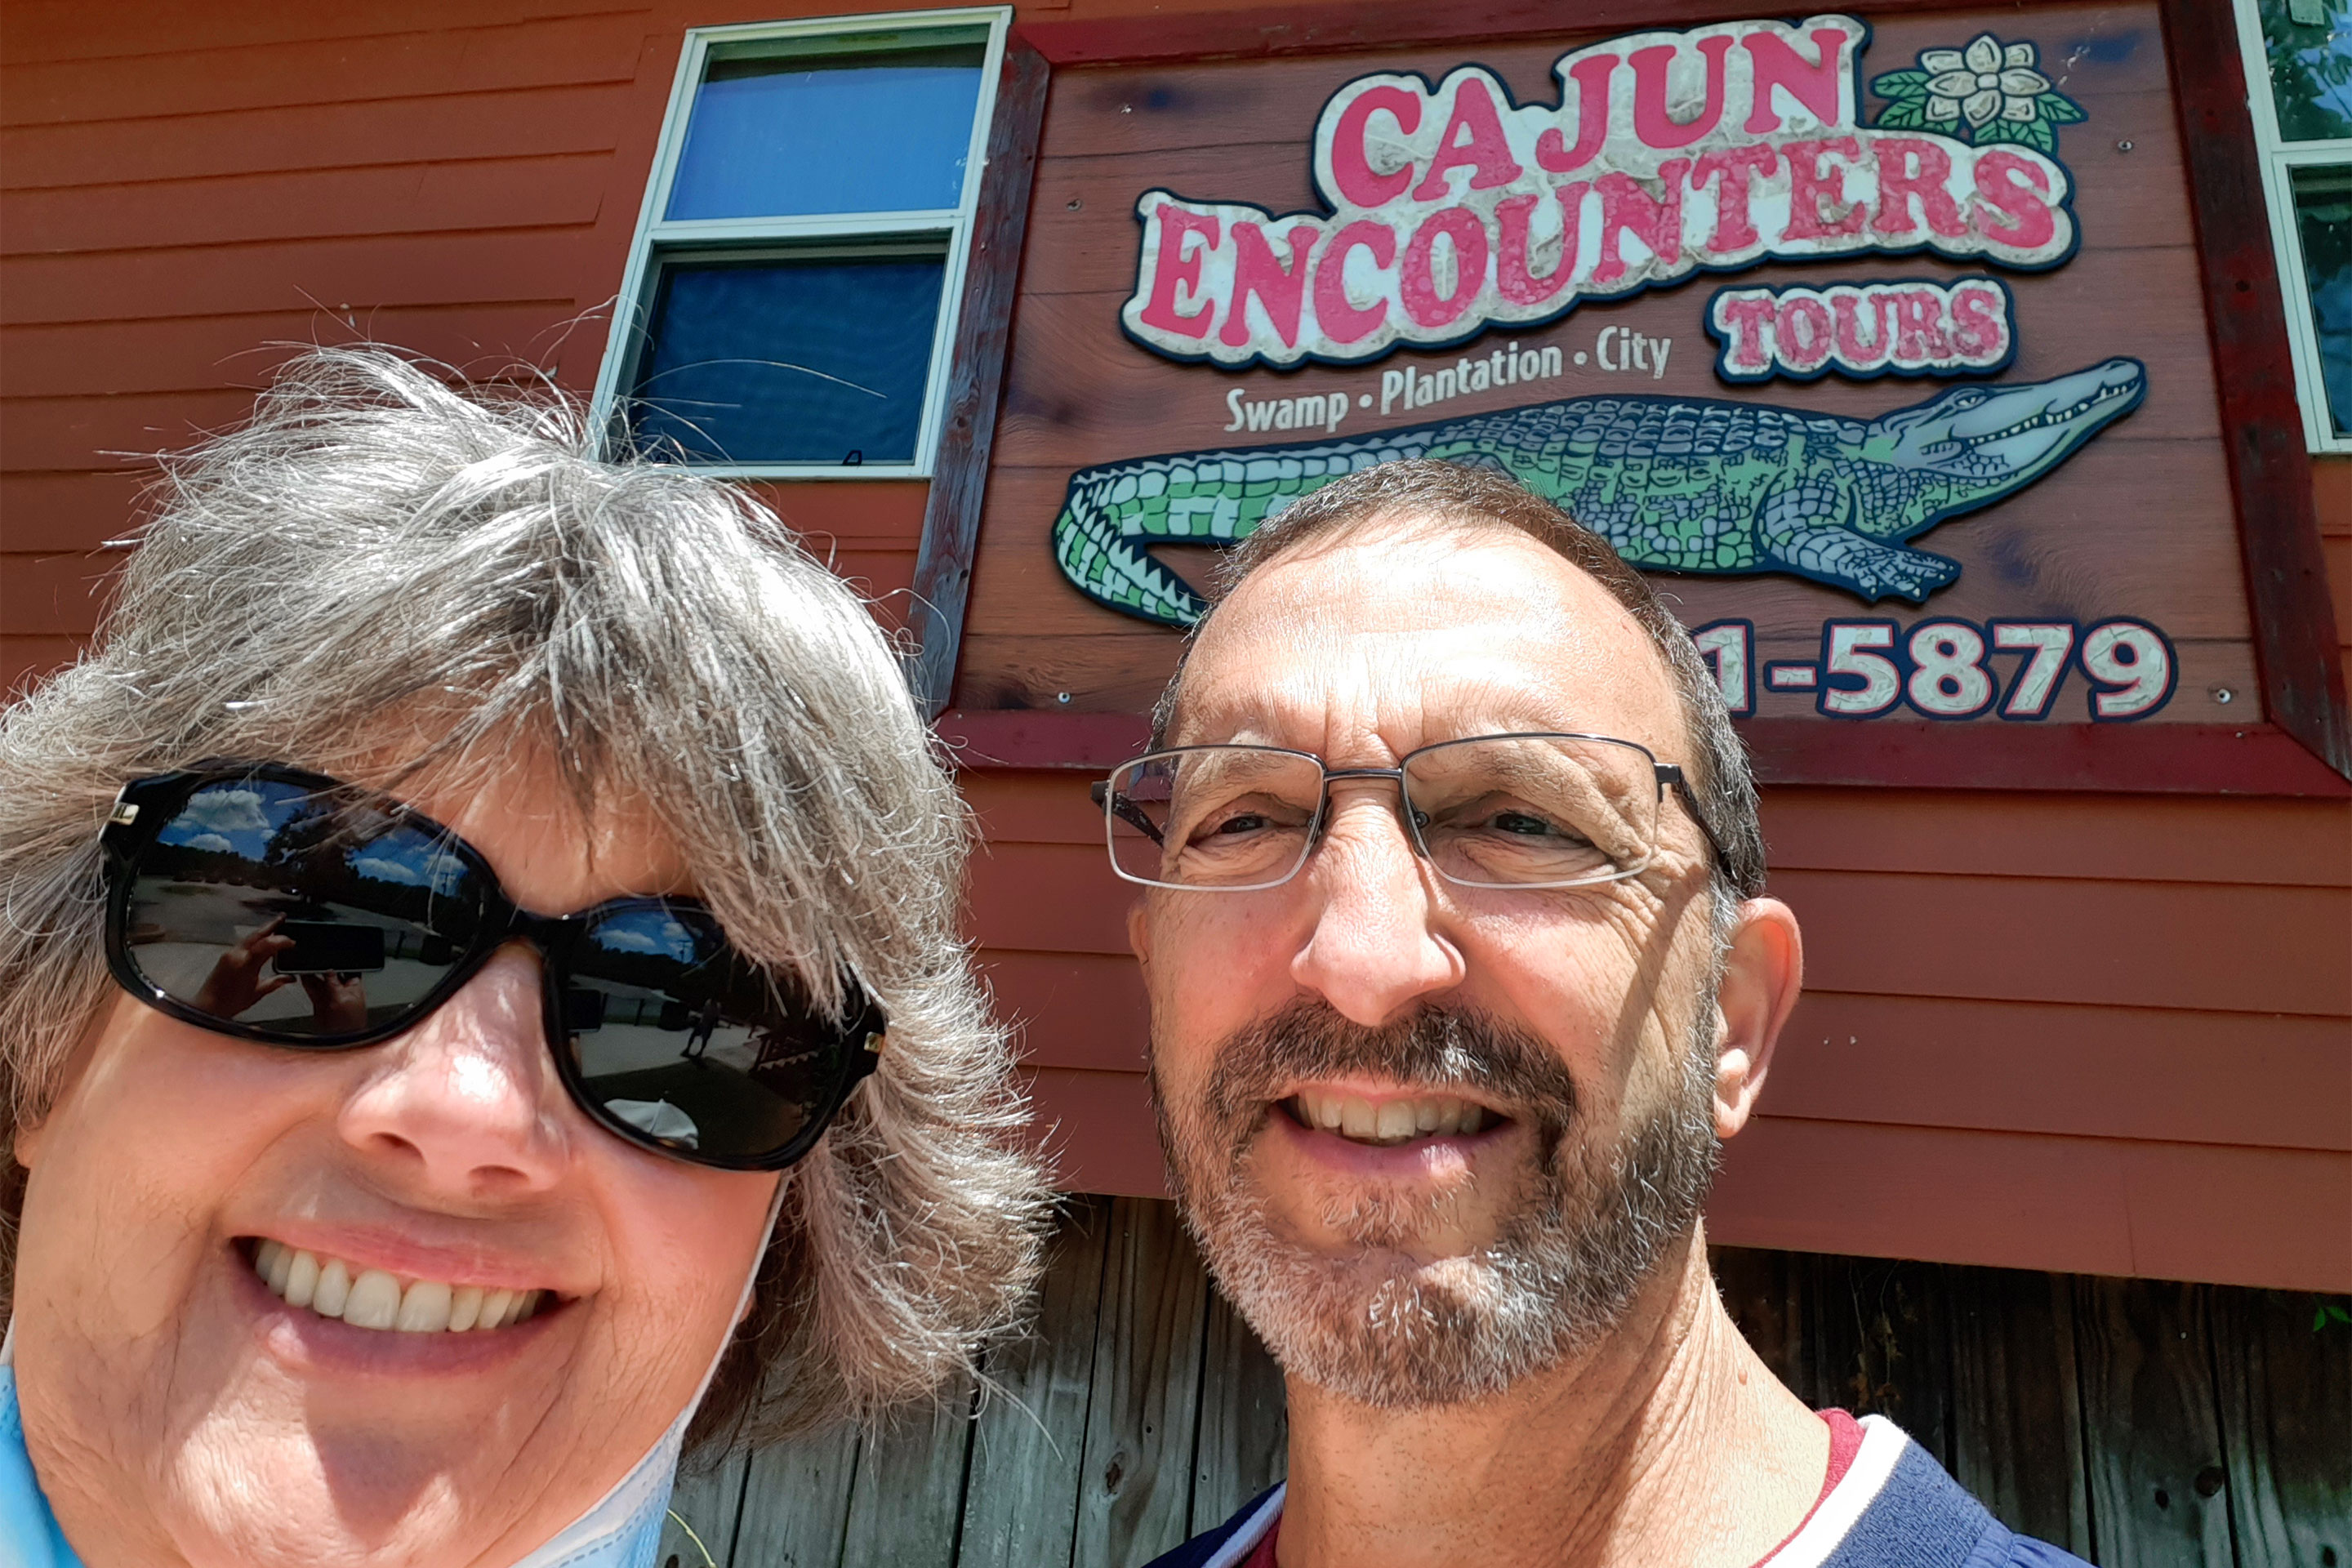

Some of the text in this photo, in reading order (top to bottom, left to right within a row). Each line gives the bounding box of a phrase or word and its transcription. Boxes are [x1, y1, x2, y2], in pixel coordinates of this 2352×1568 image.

[1330, 28, 1848, 208] CAJUN
[1139, 136, 2056, 349] ENCOUNTERS
[1223, 326, 1672, 433] Swamp Plantation City
[1722, 287, 2000, 367] TOURS
